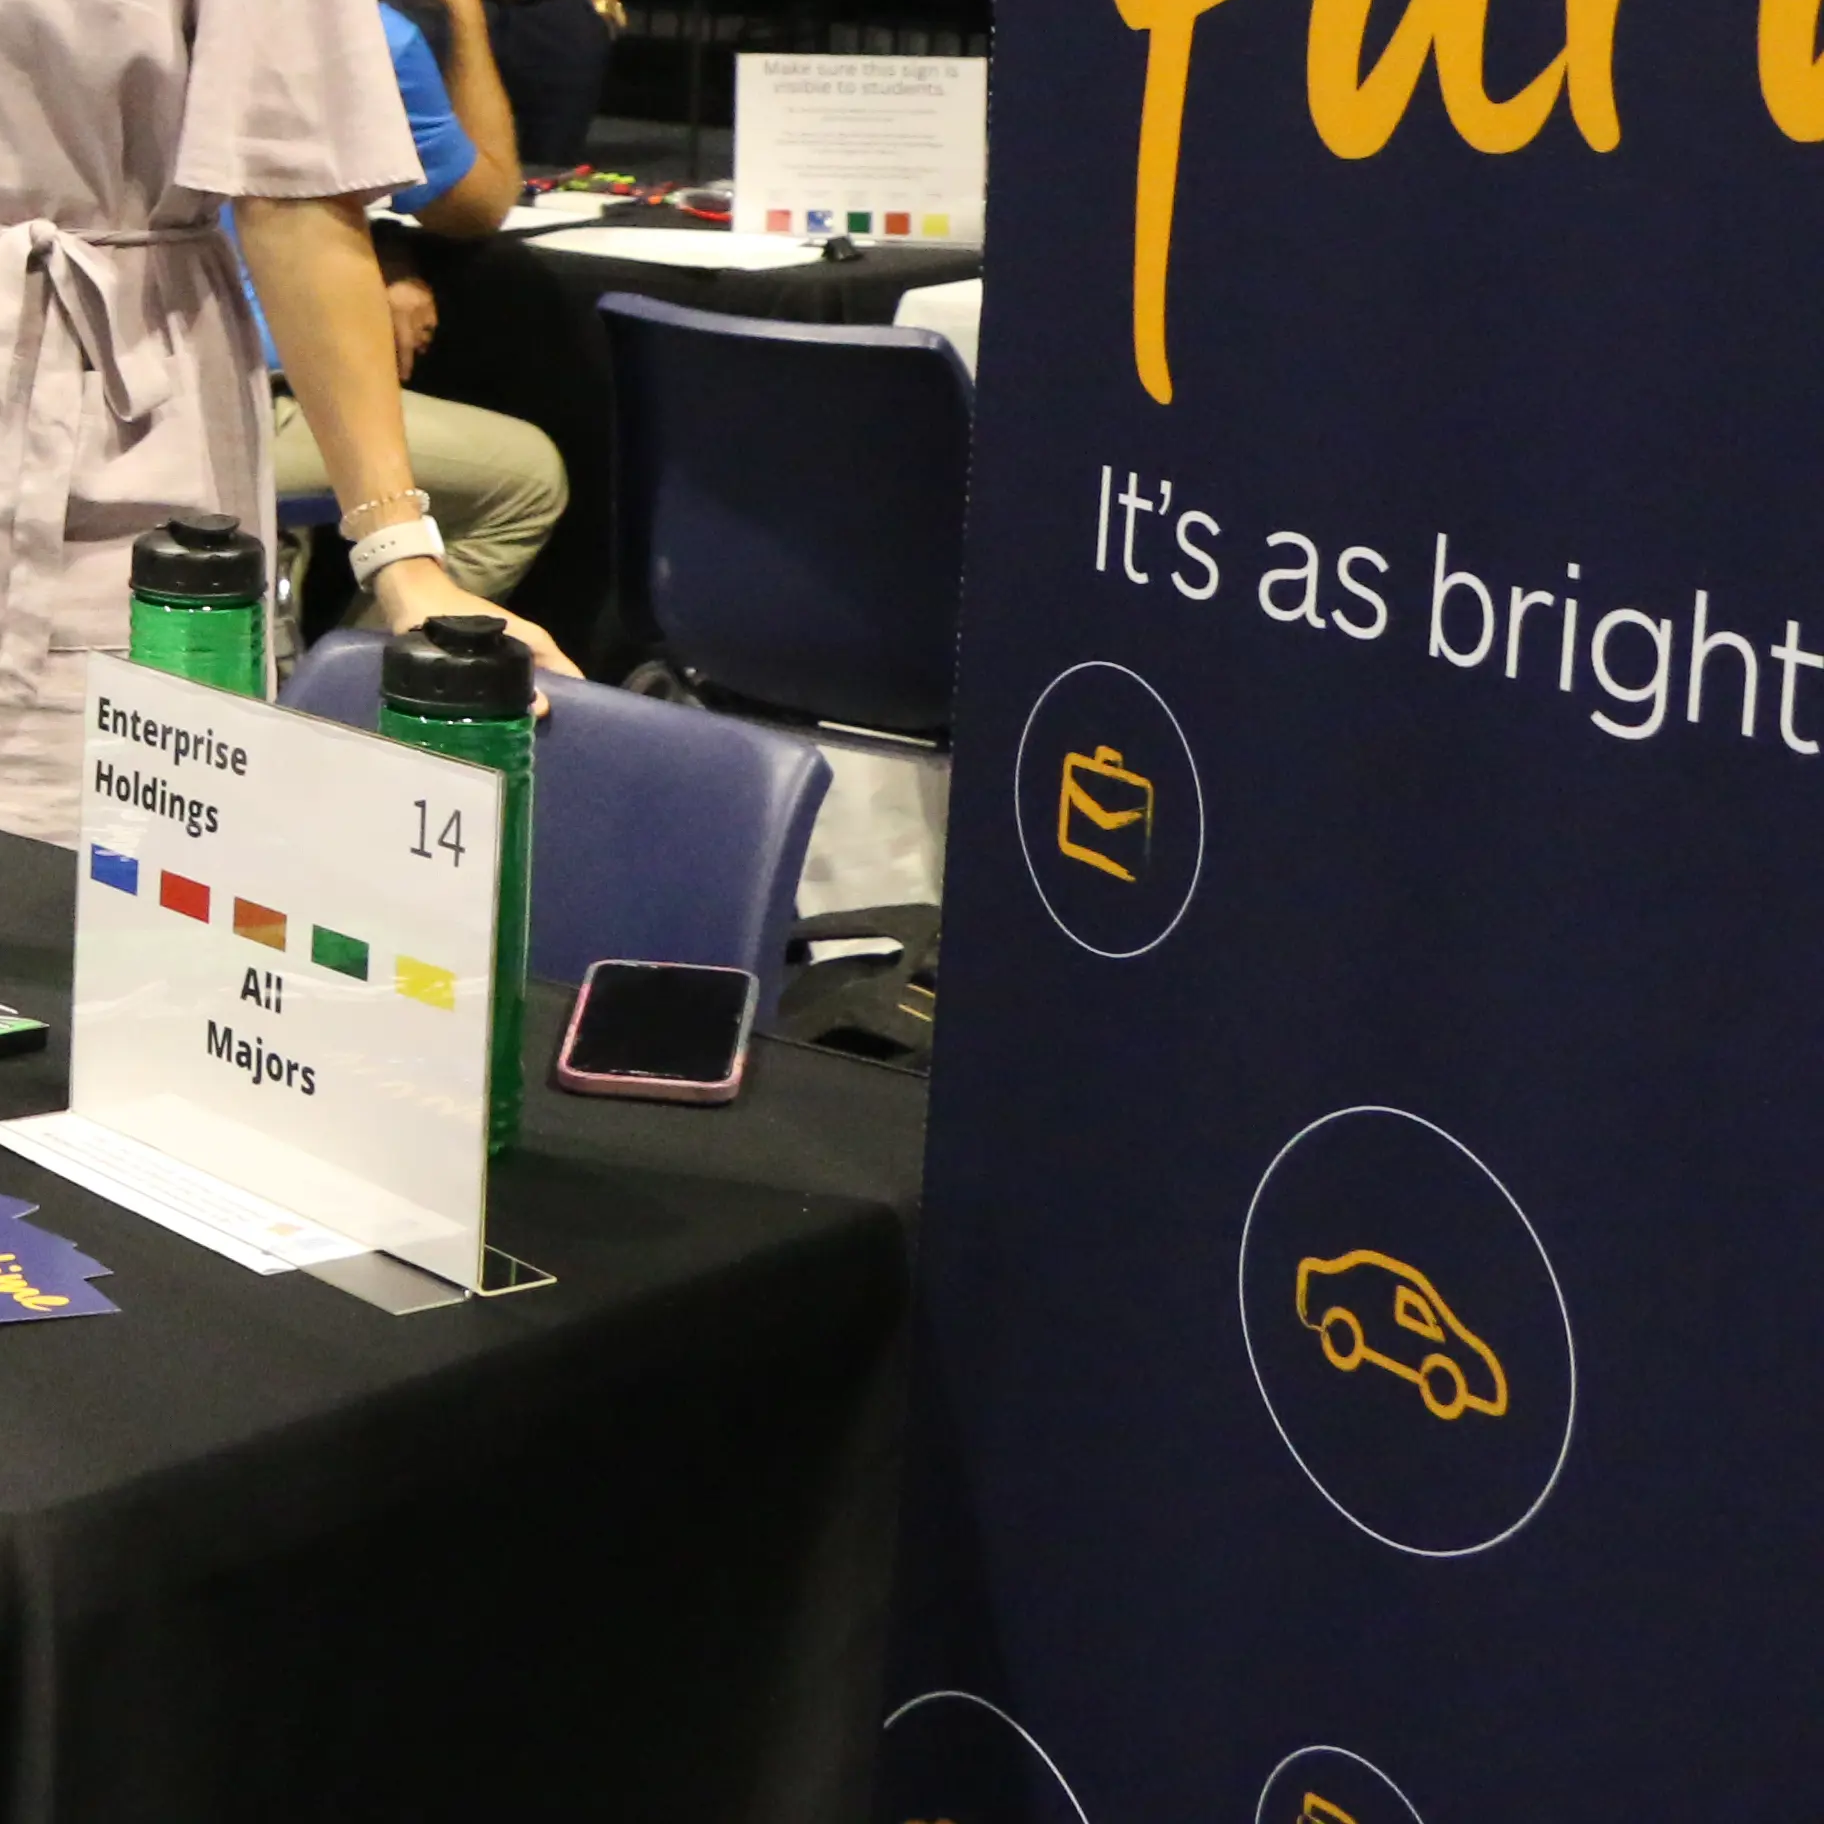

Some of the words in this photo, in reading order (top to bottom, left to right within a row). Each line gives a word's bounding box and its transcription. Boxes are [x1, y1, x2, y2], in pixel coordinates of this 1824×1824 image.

[1096, 465, 1221, 601] It’s
[1256, 529, 1389, 641] as
[1428, 532, 1824, 755] bright
[96, 696, 248, 777] Enterprise
[95, 760, 220, 838] Holdings
[409, 797, 467, 869] 14
[241, 966, 283, 1014] All
[206, 1018, 317, 1097] Majors
